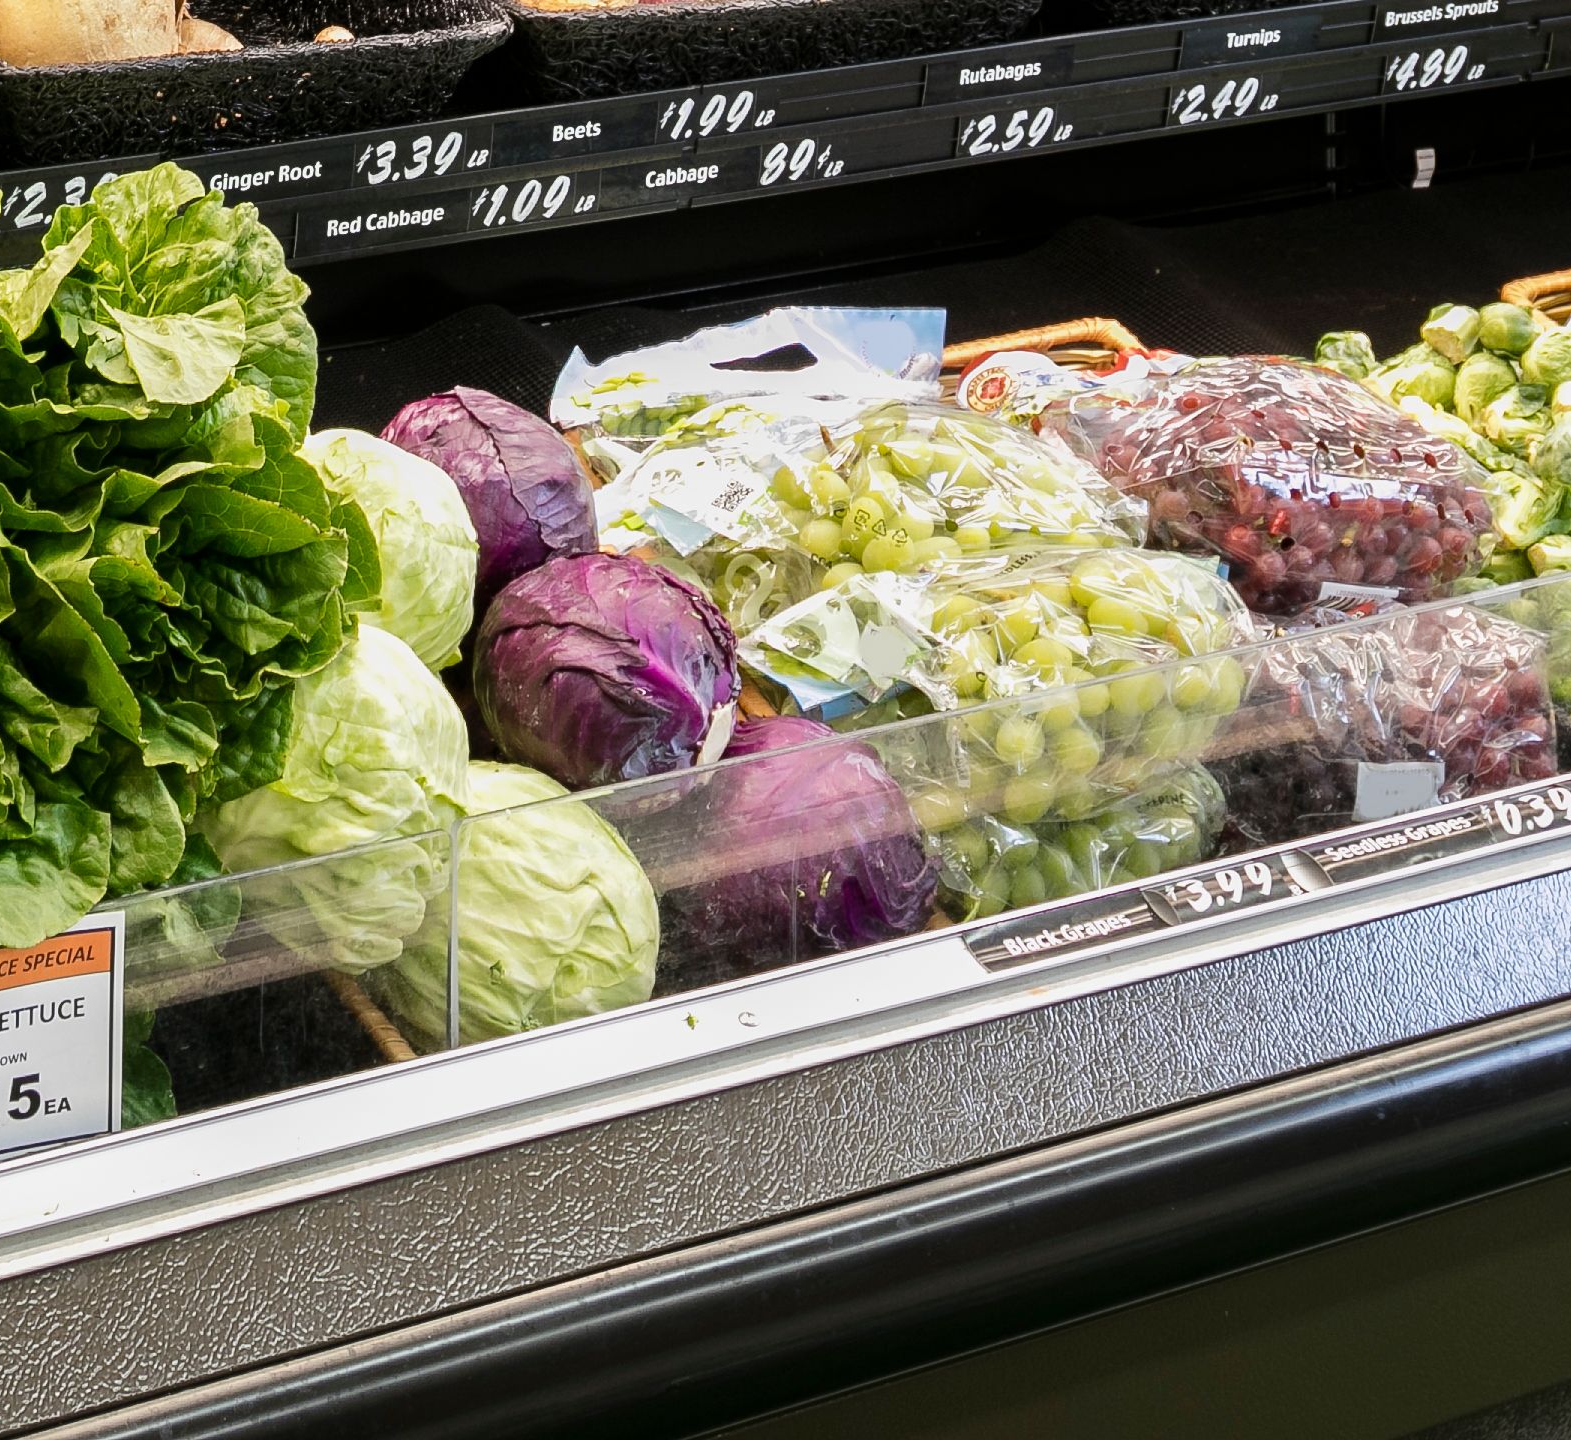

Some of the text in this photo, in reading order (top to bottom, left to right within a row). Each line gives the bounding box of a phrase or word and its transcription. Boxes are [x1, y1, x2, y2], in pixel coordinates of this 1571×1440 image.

[1227, 27, 1281, 50] Turnips
[960, 62, 1041, 86] Rutabagas
[552, 120, 601, 142] Beets
[209, 161, 322, 192] Ginger Root
[645, 163, 719, 190] Cabbage
[473, 176, 594, 226] $1.09 LB
[326, 206, 445, 238] Red Cabbage
[1323, 814, 1471, 864] Seedless Grapes
[1166, 862, 1273, 912] $3.99
[1003, 913, 1131, 957] Black Grapes
[23, 946, 95, 972] SPECIAL
